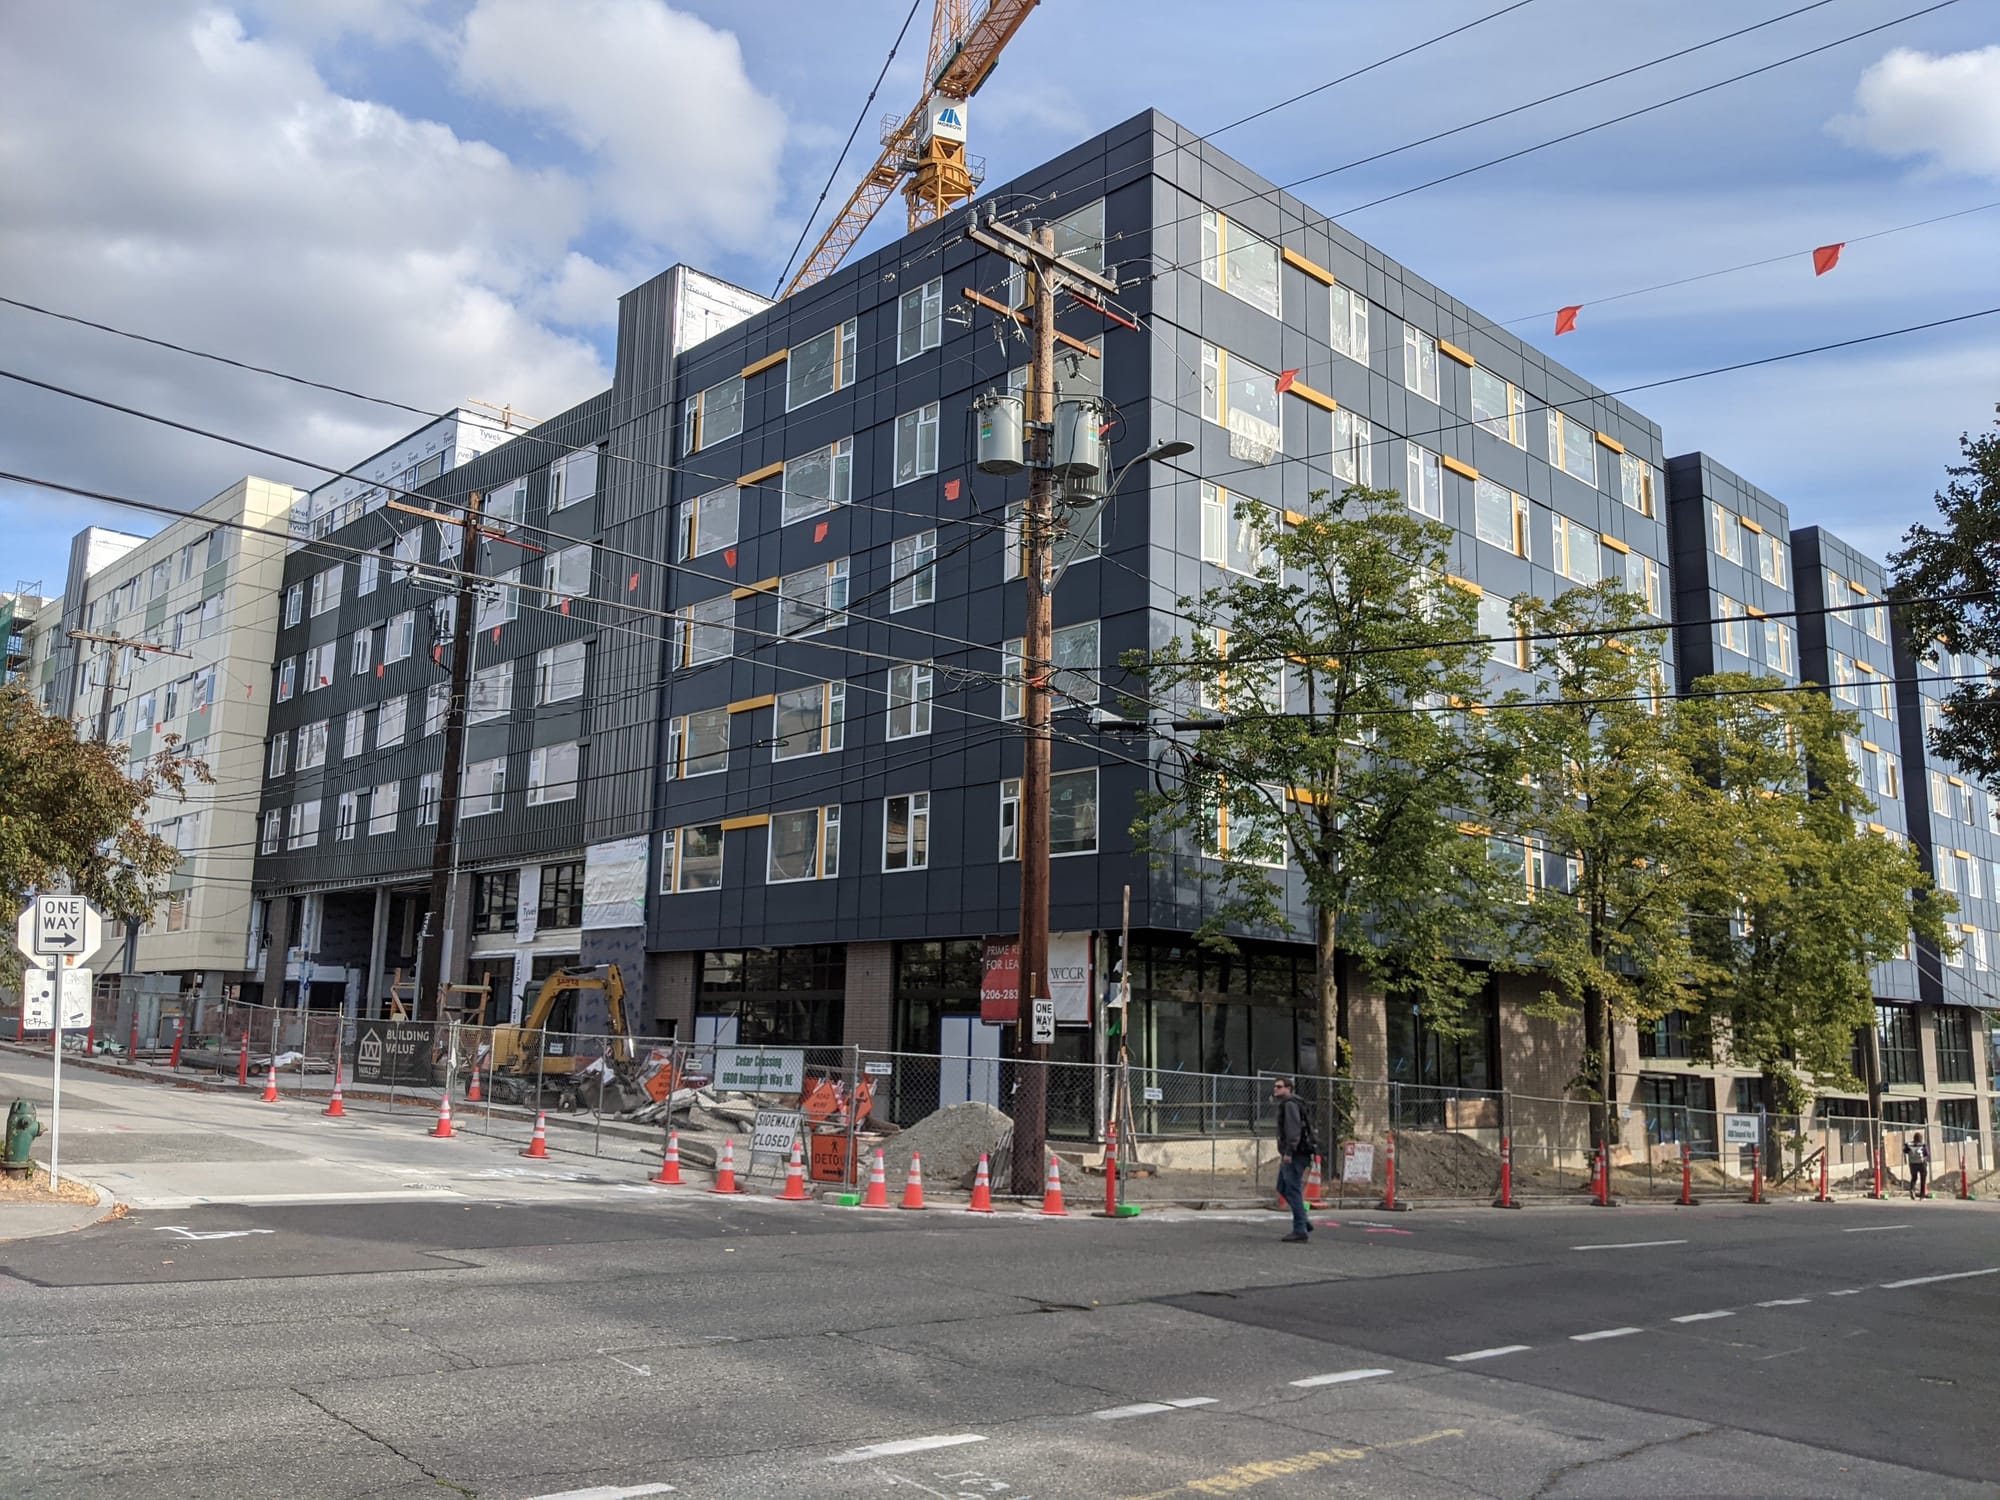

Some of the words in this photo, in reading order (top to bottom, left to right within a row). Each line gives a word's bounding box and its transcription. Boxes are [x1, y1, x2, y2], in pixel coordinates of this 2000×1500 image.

[937, 121, 962, 130] MORROW
[480, 429, 502, 441] Tyvek
[45, 901, 80, 914] ONE
[44, 917, 80, 930] WAY
[987, 945, 1009, 956] PRIME
[986, 960, 1003, 970] FOR
[1050, 967, 1085, 980] WCCR
[1036, 1003, 1053, 1014] ONE
[1036, 1016, 1053, 1026] WAY
[386, 1029, 430, 1041] BUILDING
[385, 1043, 415, 1054] VALUE
[769, 1074, 783, 1087] Way
[757, 1114, 797, 1128] SIDEWALK
[753, 1133, 790, 1148] CLOSED
